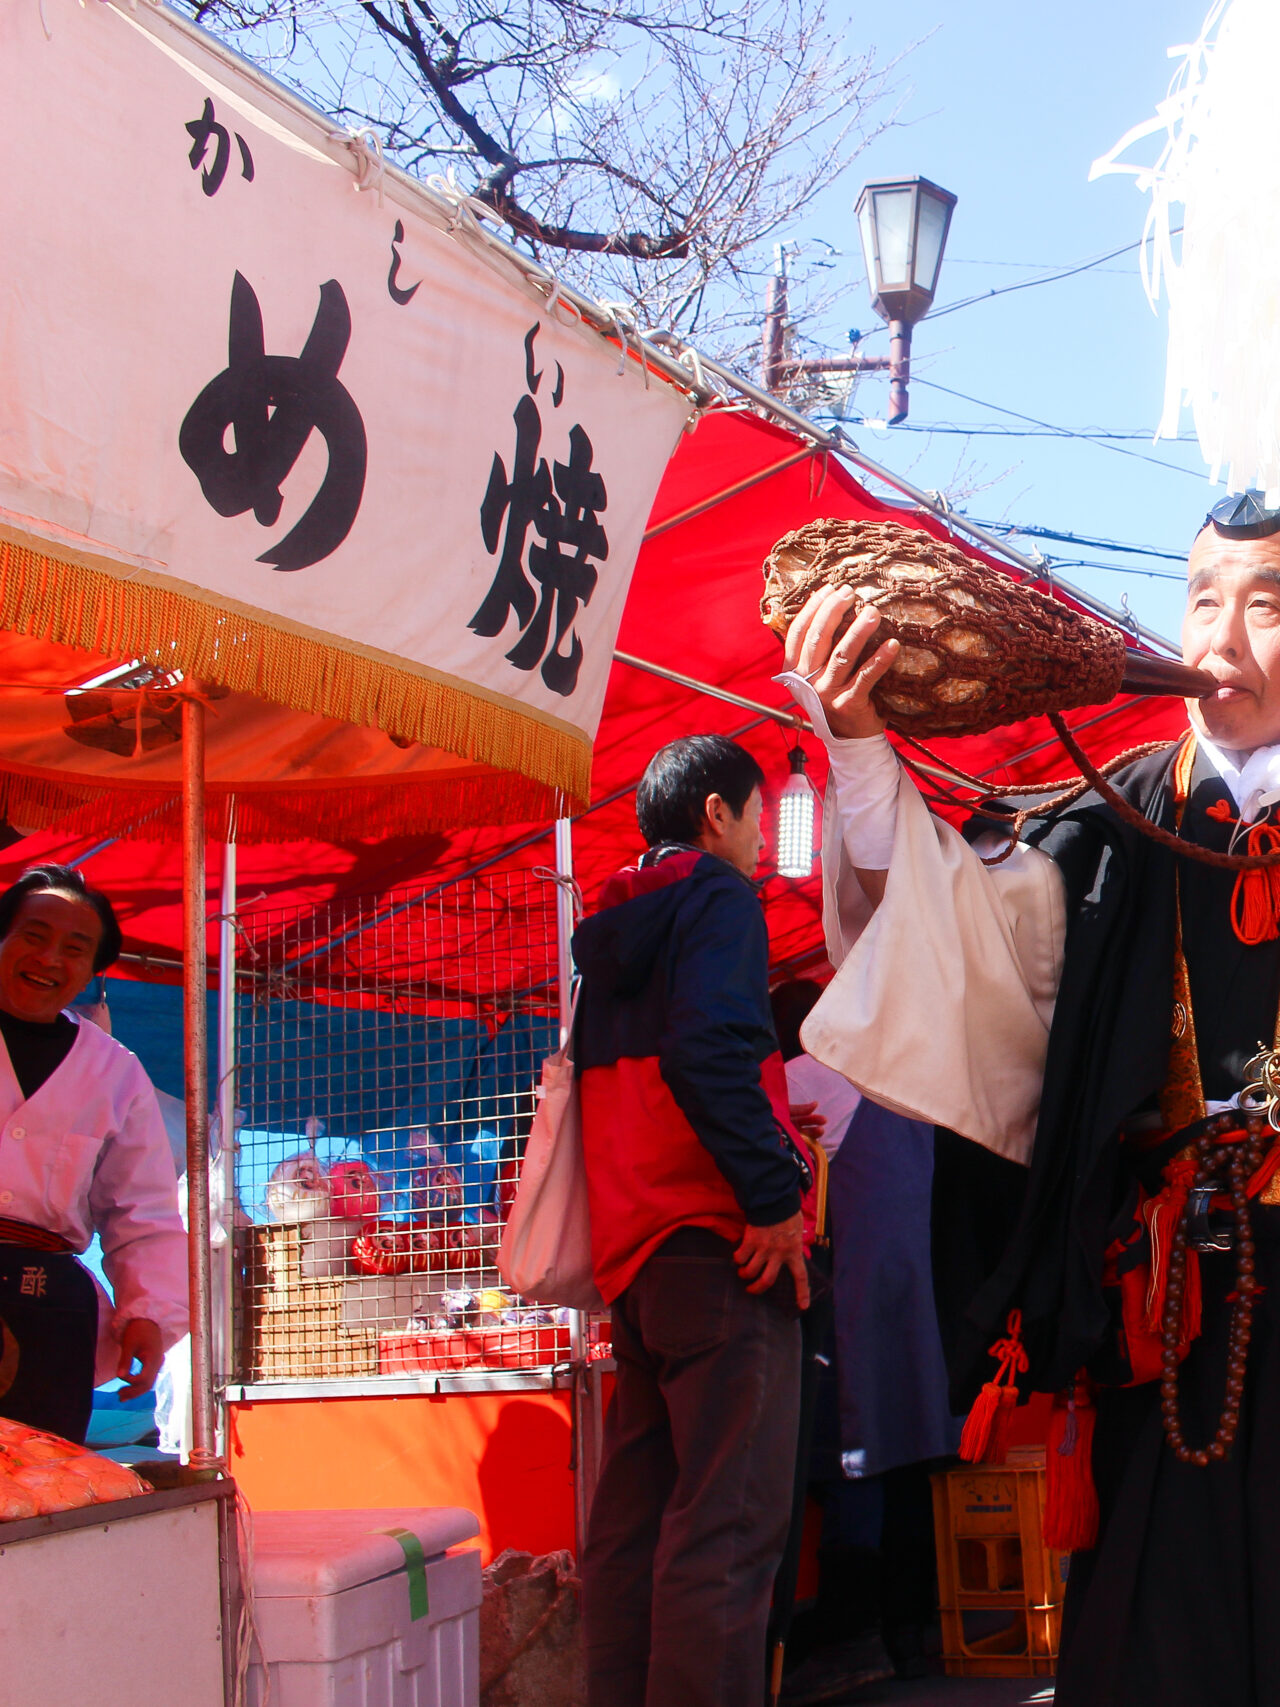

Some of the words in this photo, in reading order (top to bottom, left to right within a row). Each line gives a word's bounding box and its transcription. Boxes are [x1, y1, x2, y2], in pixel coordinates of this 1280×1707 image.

[184, 96, 565, 408] かしい
[178, 268, 609, 698] め焼
